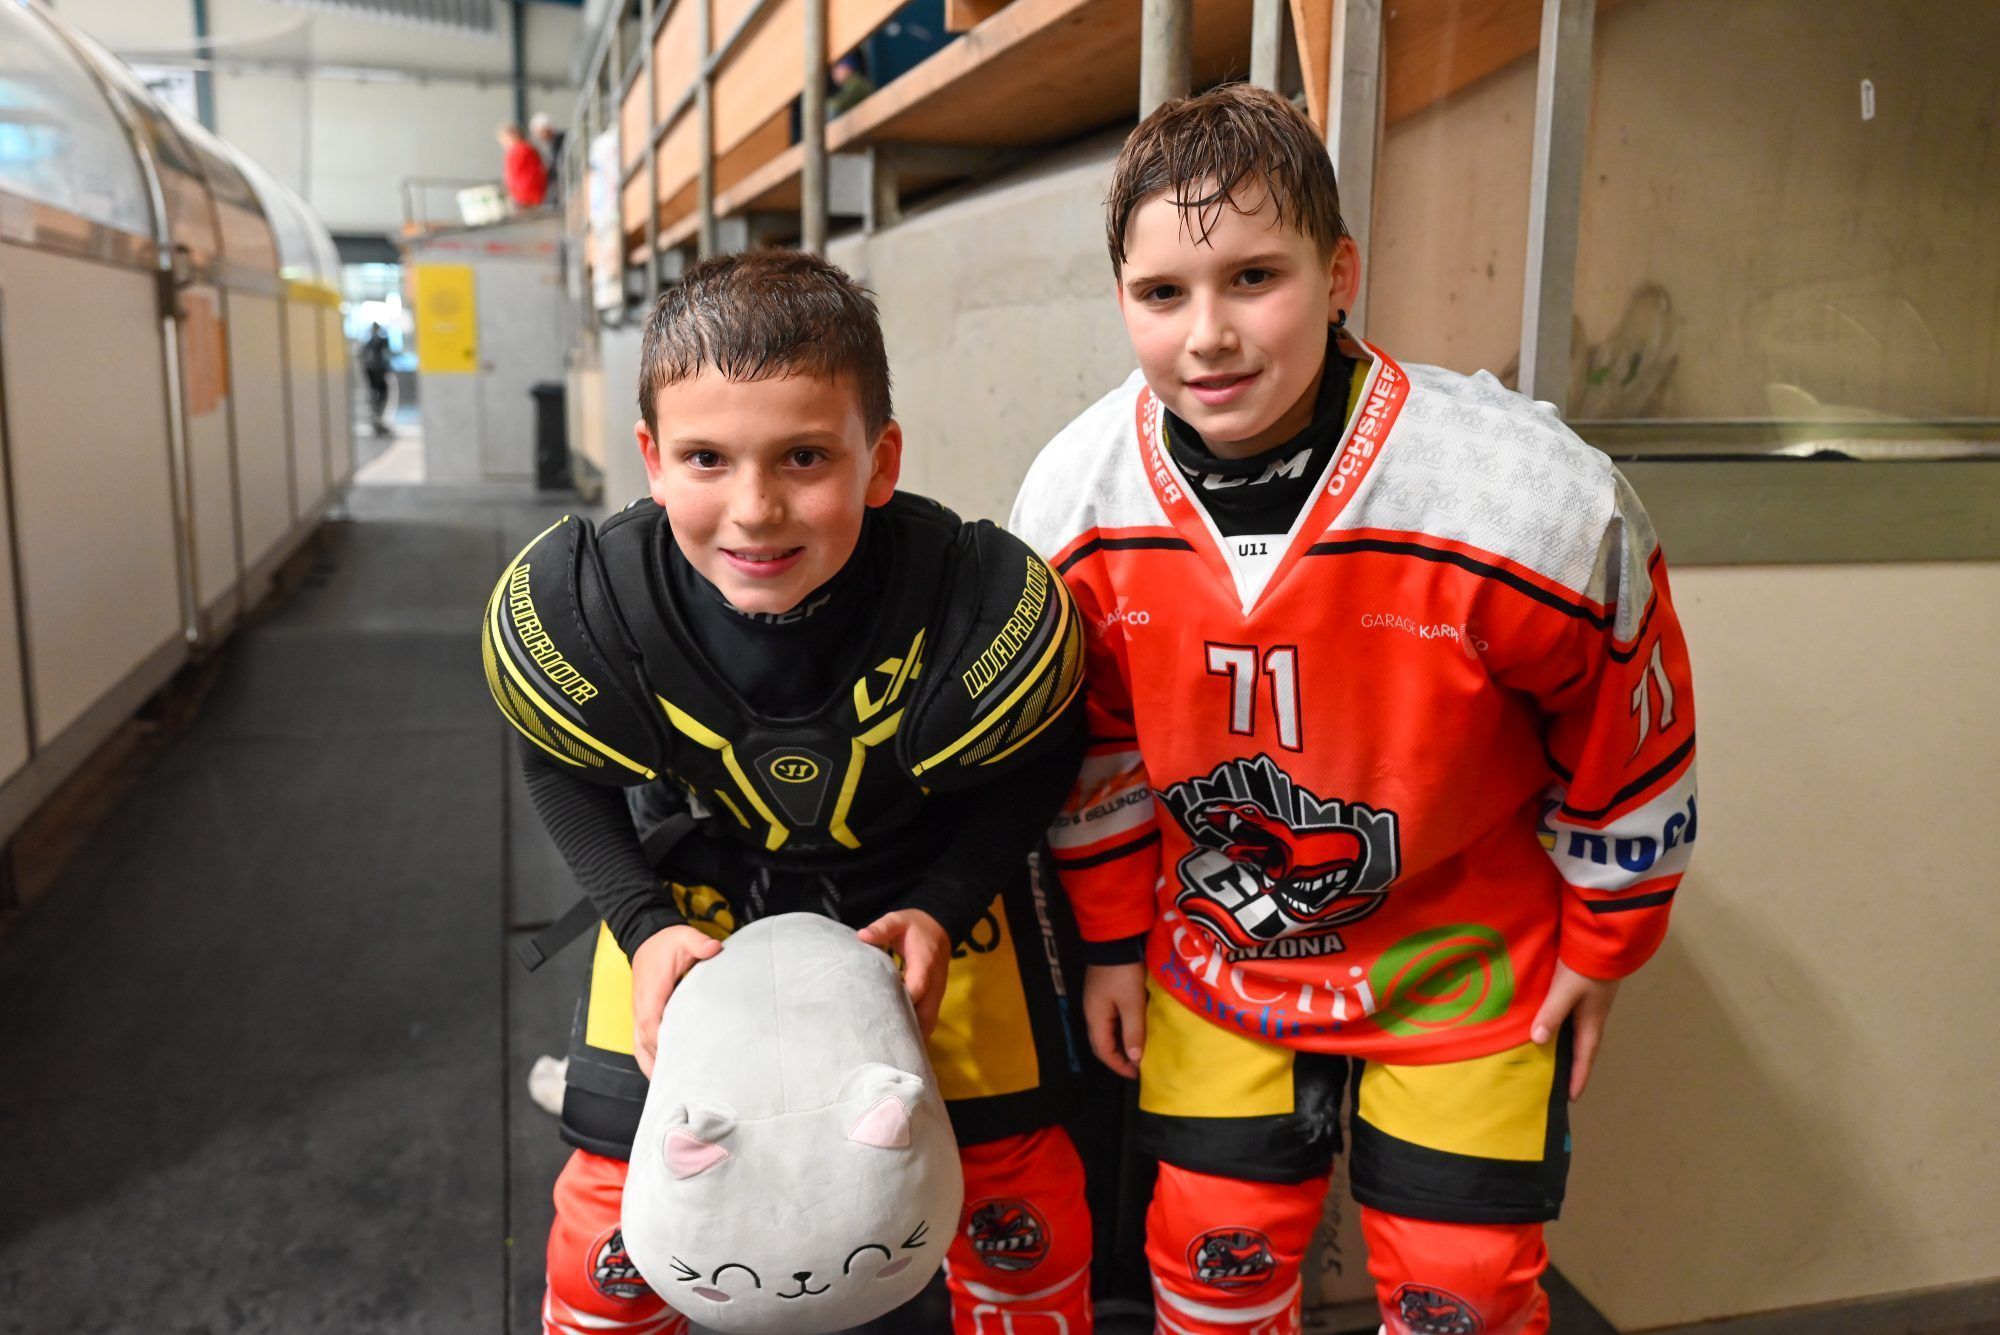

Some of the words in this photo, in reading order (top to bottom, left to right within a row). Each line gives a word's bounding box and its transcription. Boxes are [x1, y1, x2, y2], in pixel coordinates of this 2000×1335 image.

[1327, 363, 1397, 496] OCHSNER
[1238, 542, 1268, 557] U11
[509, 563, 599, 706] WARRIOR
[962, 555, 1048, 700] WARRIOR
[1206, 641, 1303, 753] 71
[1626, 634, 1677, 765] 71
[1084, 786, 1150, 822] BELLINZO
